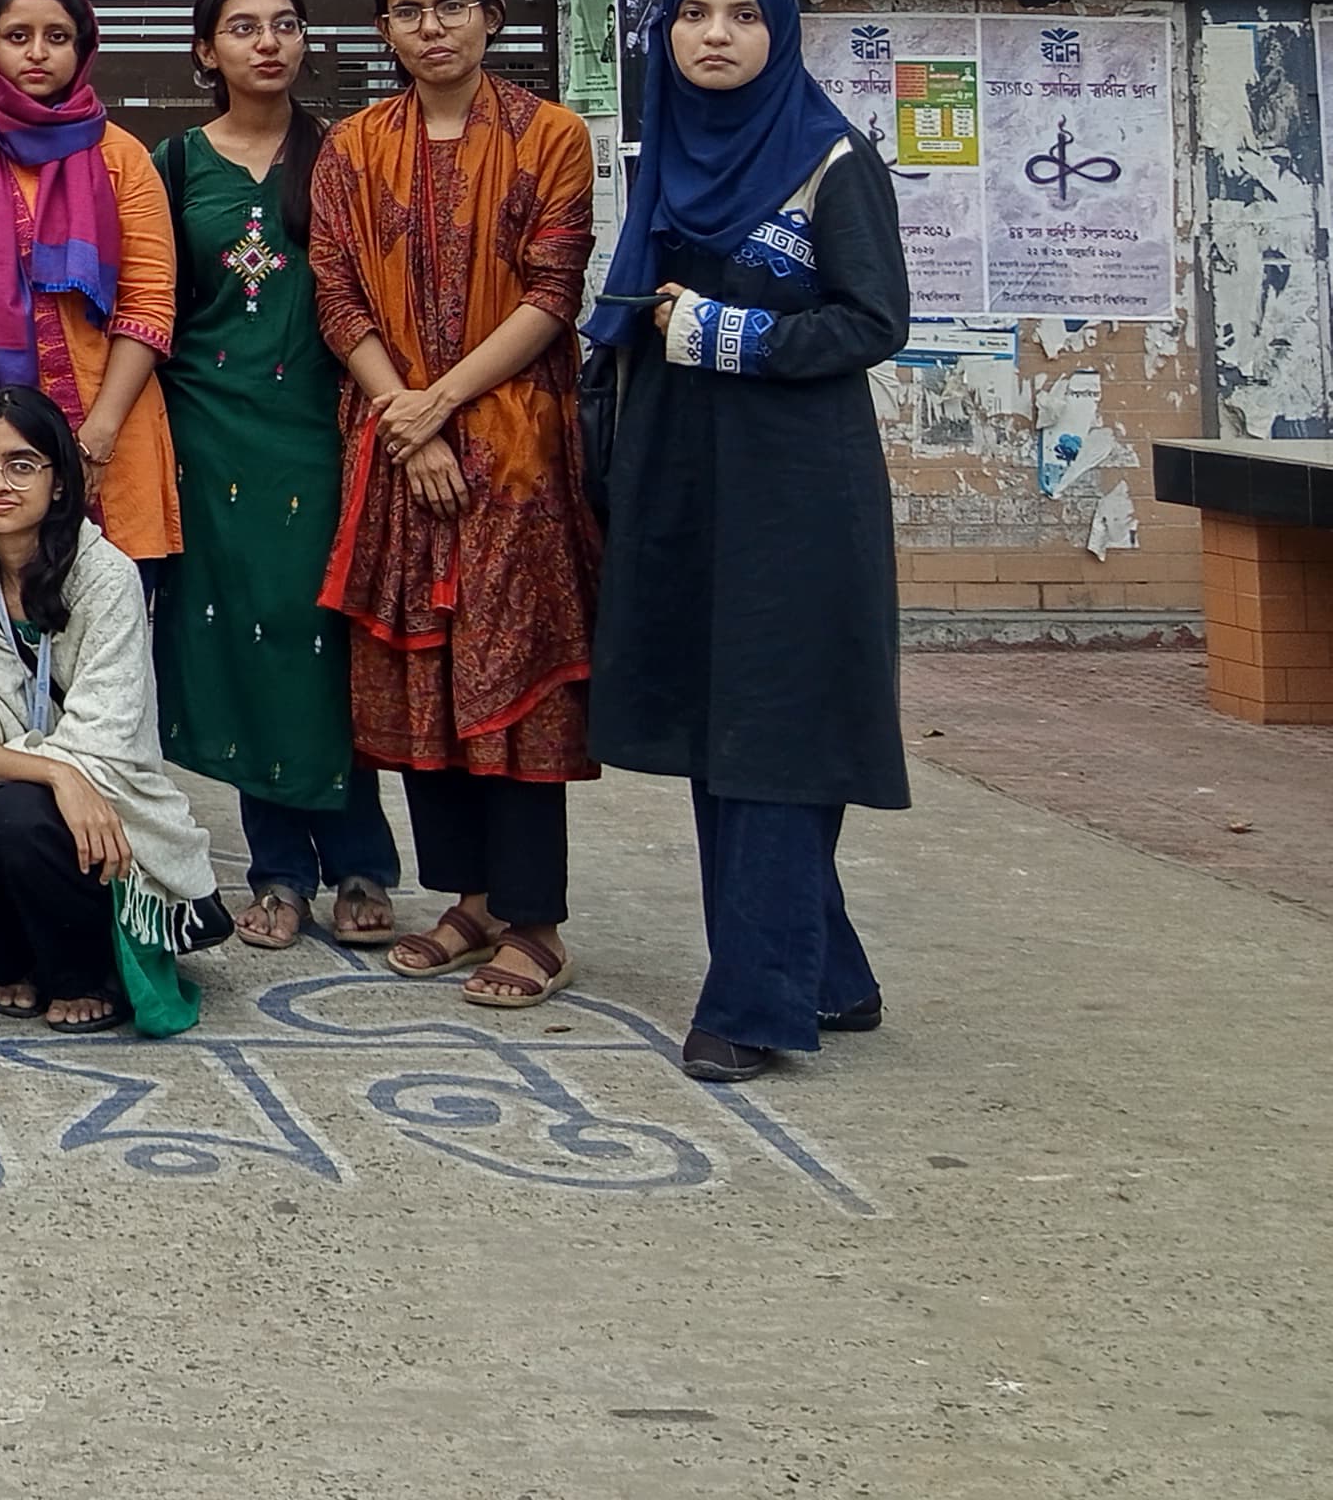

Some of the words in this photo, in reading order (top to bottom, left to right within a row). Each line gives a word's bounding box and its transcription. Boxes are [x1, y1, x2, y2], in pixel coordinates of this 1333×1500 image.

[985, 81, 1032, 97] জাগাও
[1039, 73, 1081, 98] আদিম
[1131, 84, 1156, 99] প্রাণ
